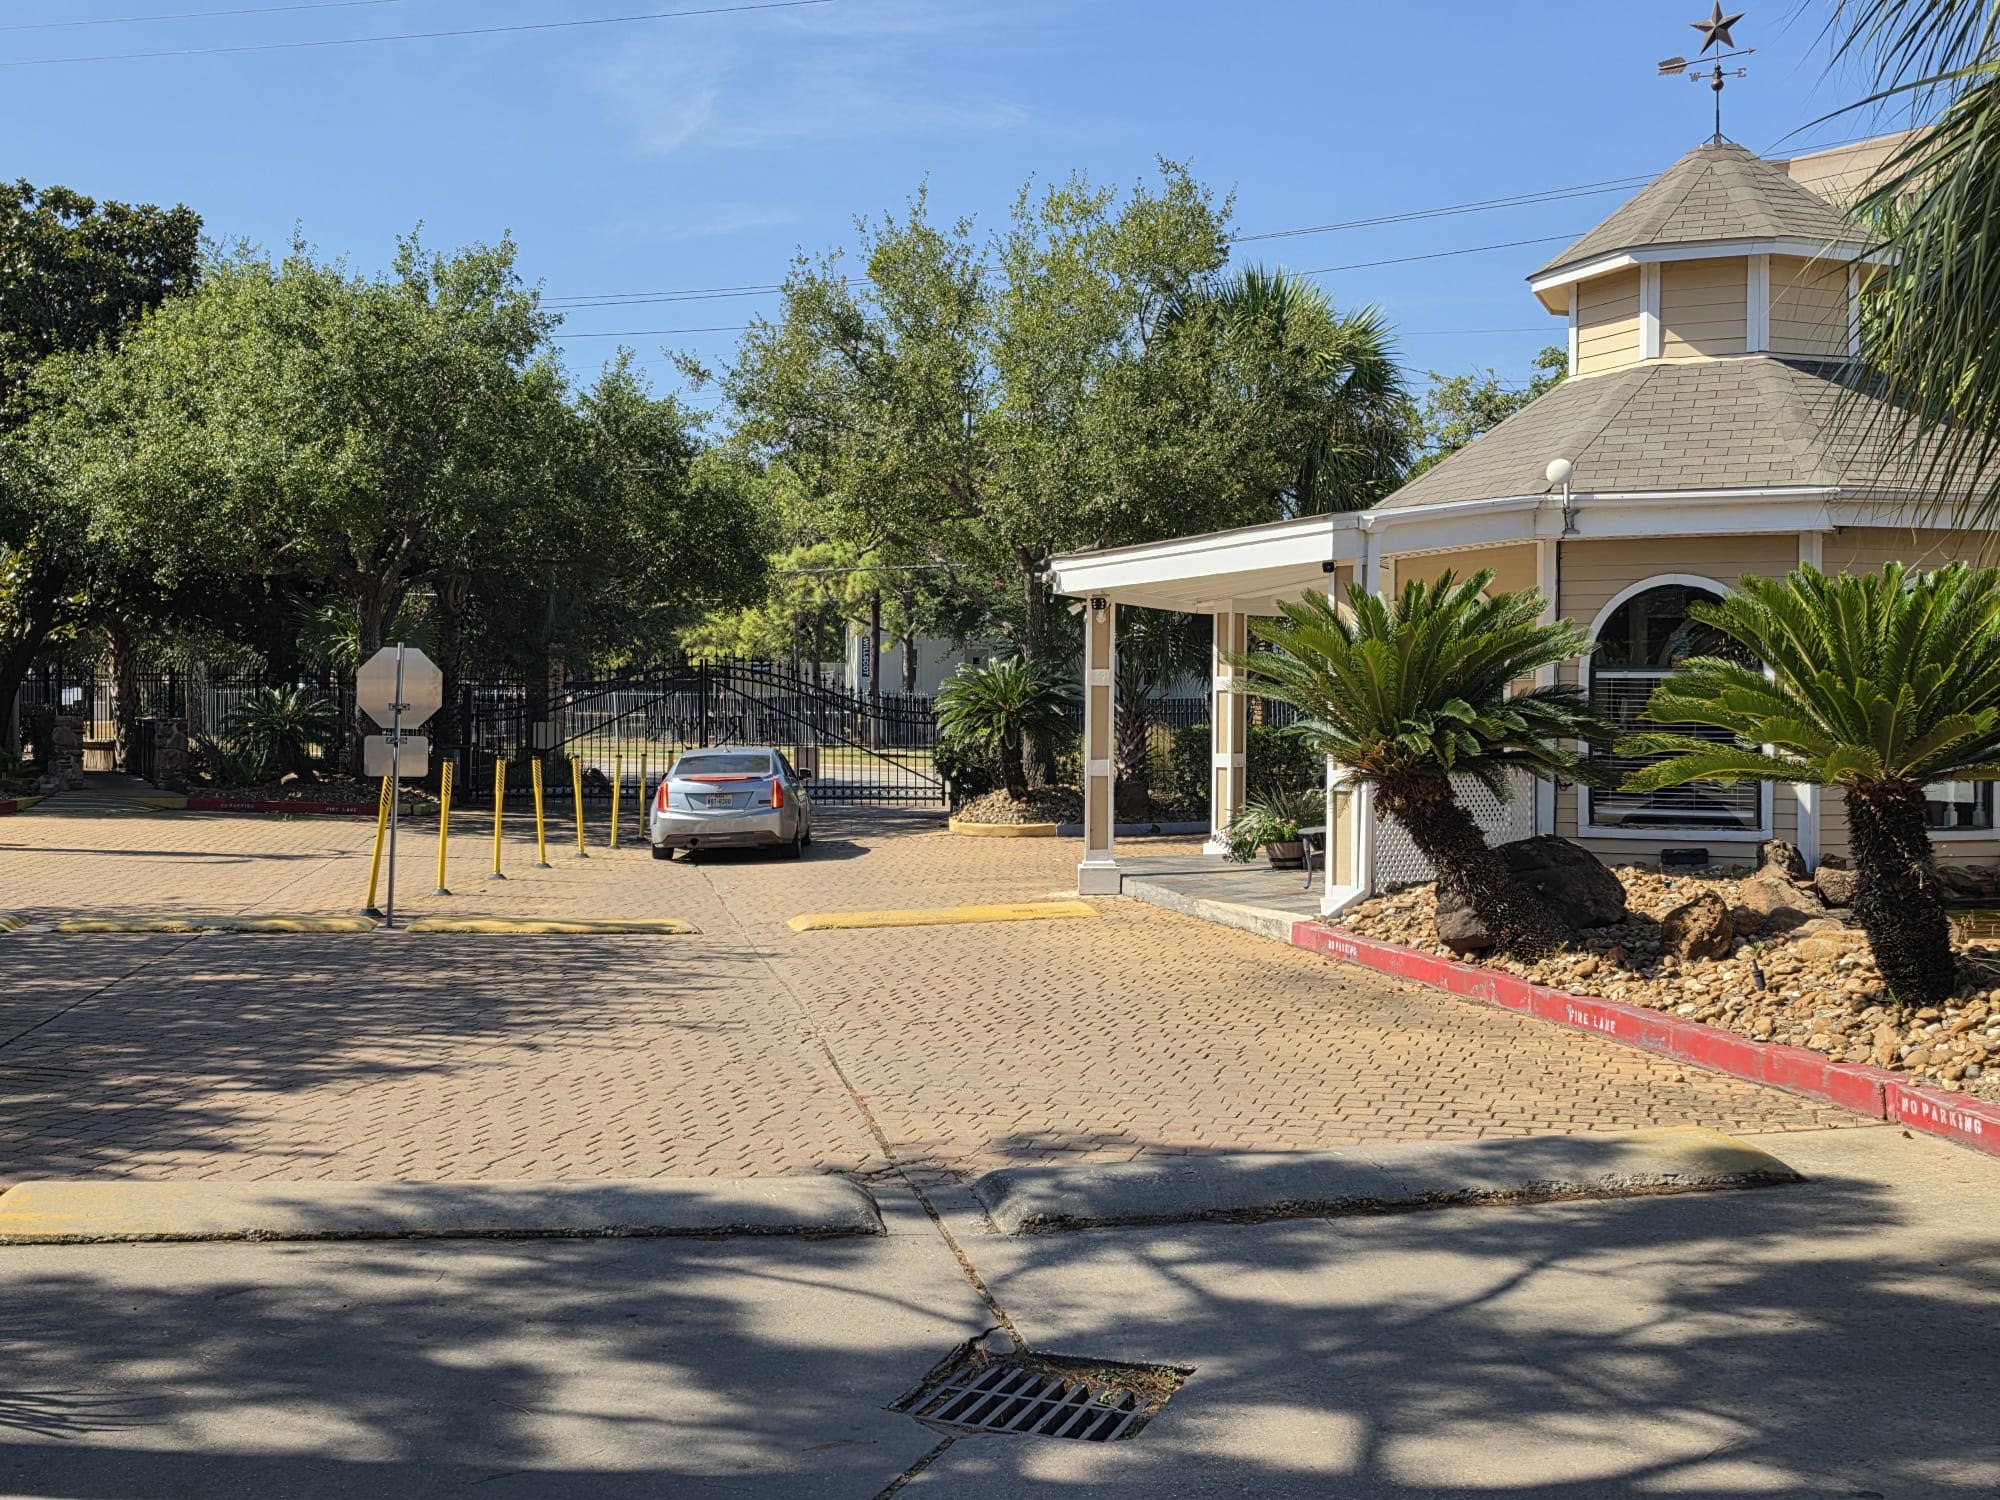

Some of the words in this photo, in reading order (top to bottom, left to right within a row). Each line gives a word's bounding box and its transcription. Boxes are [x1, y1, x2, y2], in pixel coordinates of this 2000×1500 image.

[1689, 72, 1701, 82] W
[1737, 67, 1747, 78] E
[862, 637, 870, 676] WILLSCOT
[1569, 1008, 1589, 1025] FIRE
[1593, 1015, 1616, 1034] LANE
[1901, 1096, 1918, 1115] NO
[1922, 1102, 1983, 1135] PARKING
